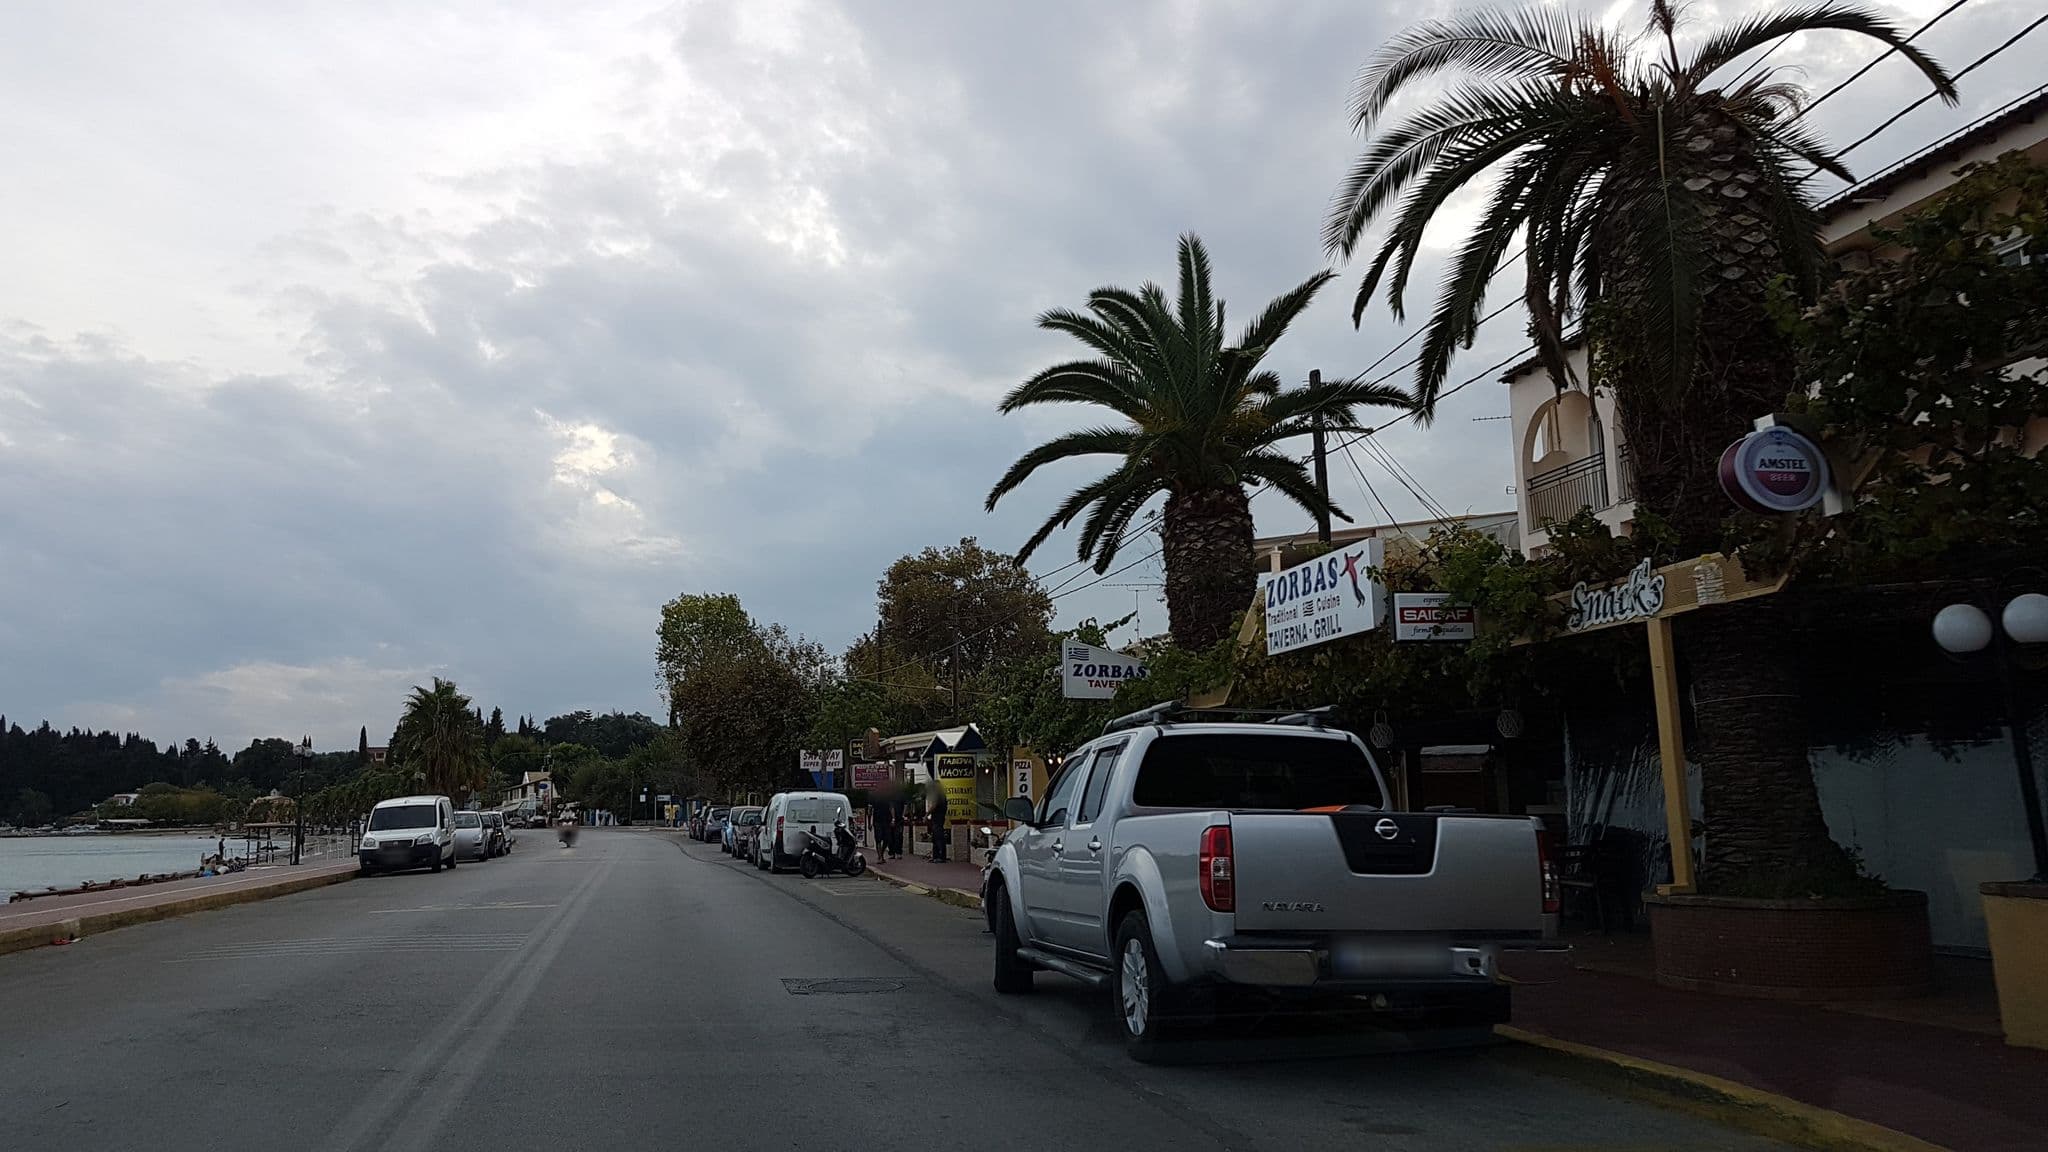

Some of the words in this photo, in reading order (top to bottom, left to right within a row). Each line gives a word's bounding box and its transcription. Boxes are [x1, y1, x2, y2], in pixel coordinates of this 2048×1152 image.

[1759, 458, 1807, 470] AMSTEL
[1266, 557, 1338, 608] ZORBAS
[1268, 605, 1298, 624] Traditional
[1316, 595, 1340, 612] Cuisine
[1073, 664, 1148, 678] ZORBAS
[1088, 680, 1121, 689] TAVER
[1014, 761, 1031, 769] PIZZA
[1262, 901, 1325, 913] NAVARA
